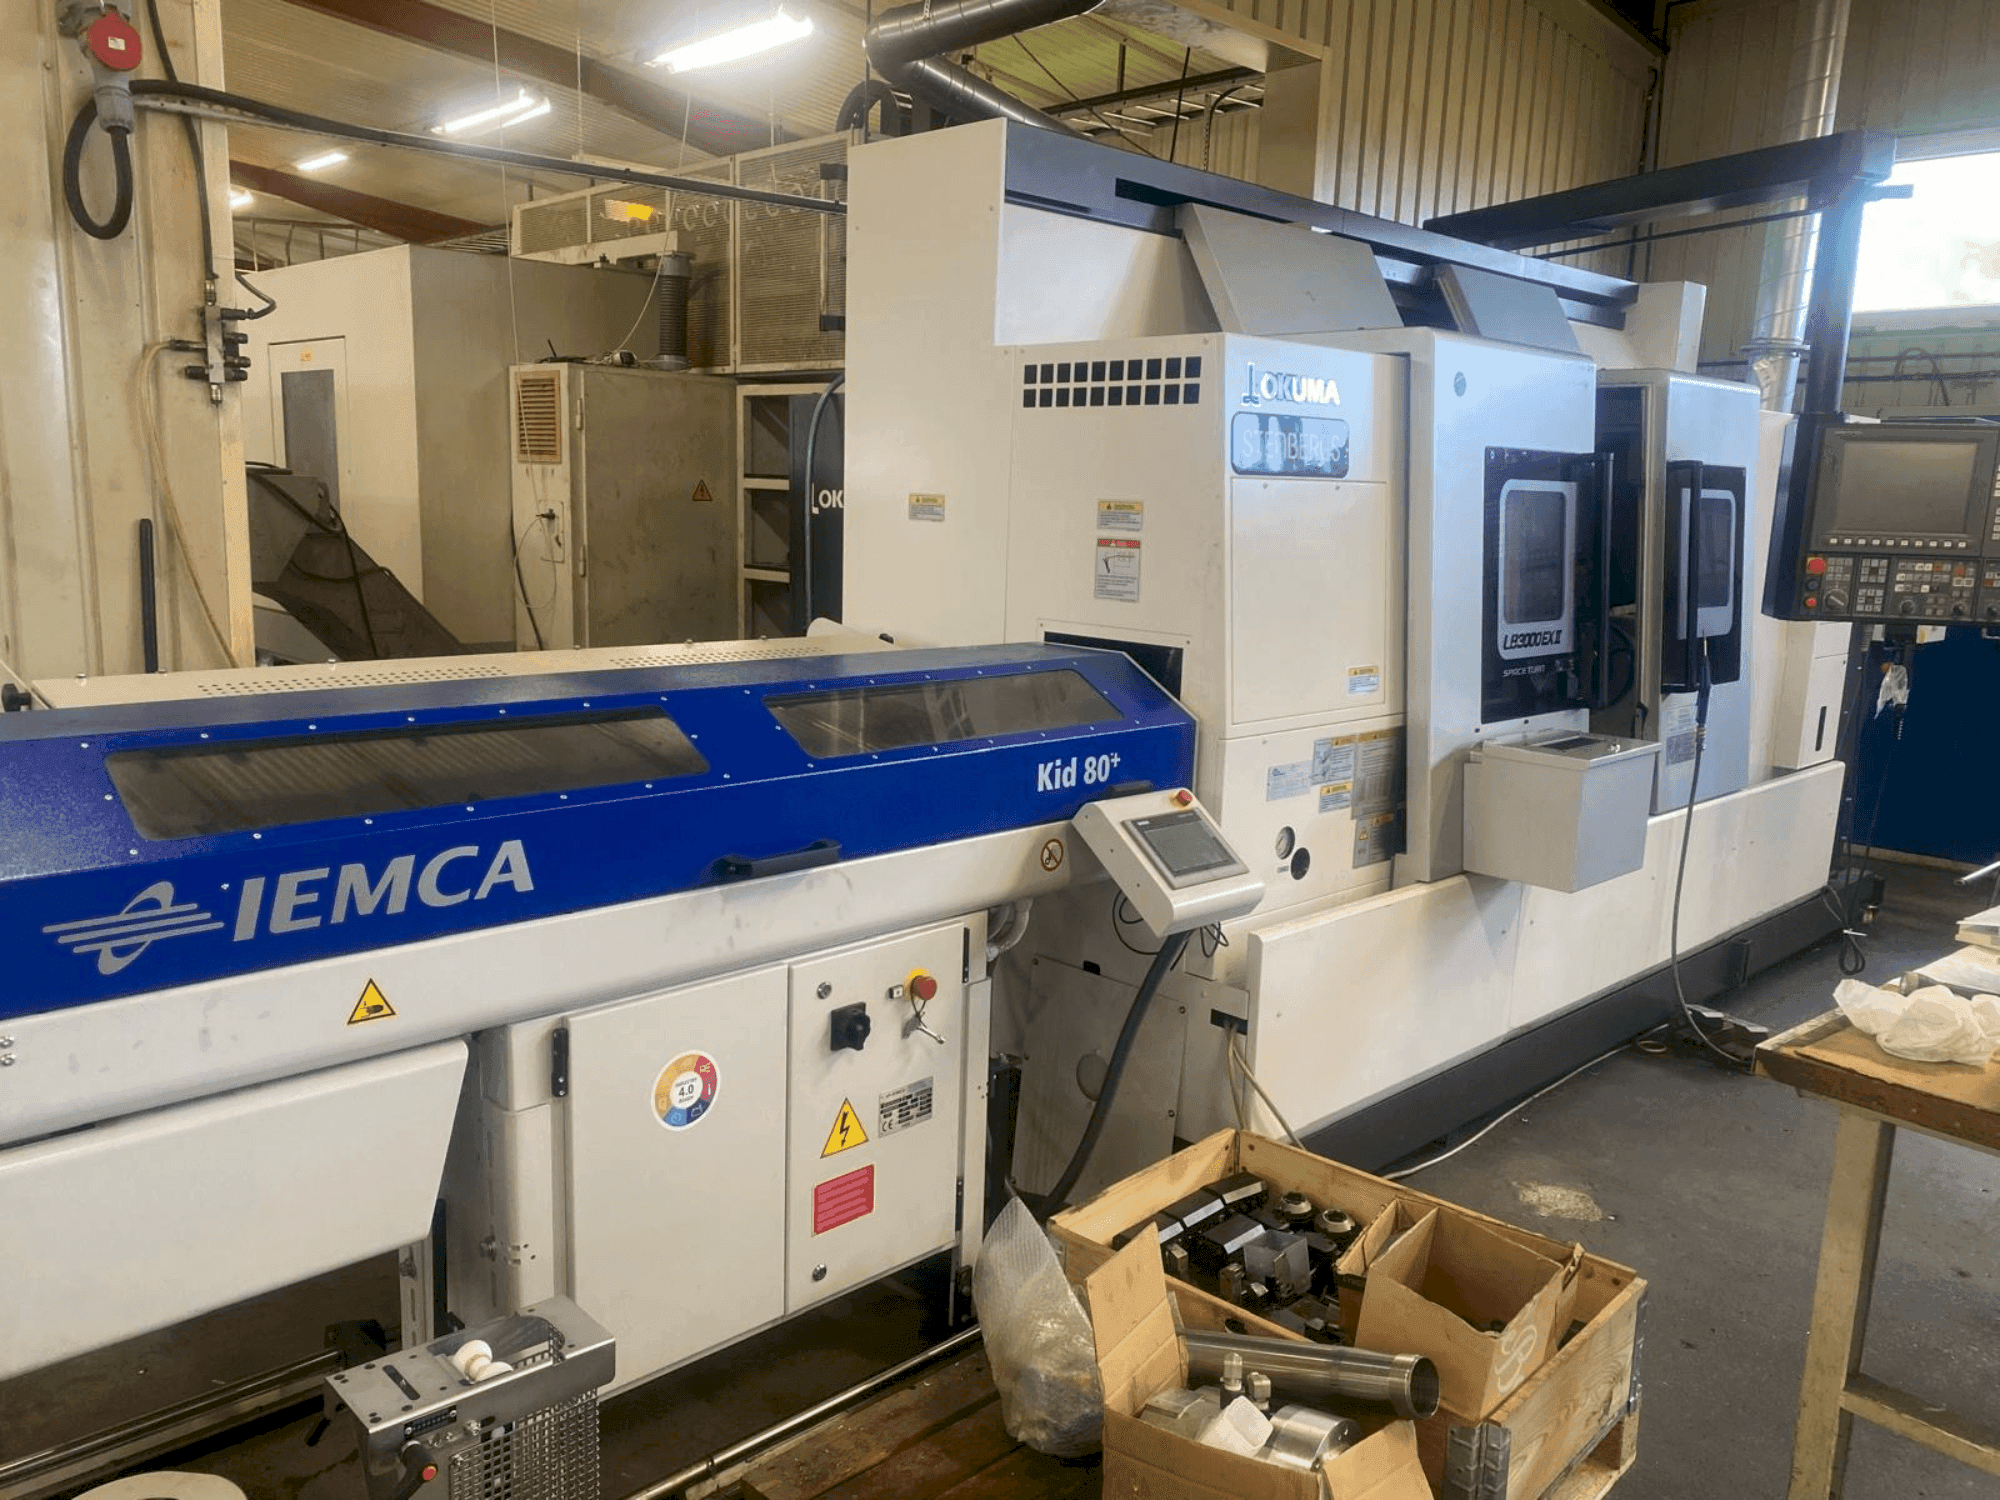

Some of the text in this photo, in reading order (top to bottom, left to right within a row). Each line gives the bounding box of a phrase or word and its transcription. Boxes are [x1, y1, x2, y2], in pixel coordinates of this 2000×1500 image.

[1260, 372, 1340, 406] OKUMA
[1037, 757, 1076, 792] Kid
[233, 839, 534, 942] IEMCA
[678, 1083, 695, 1096] 4.0
